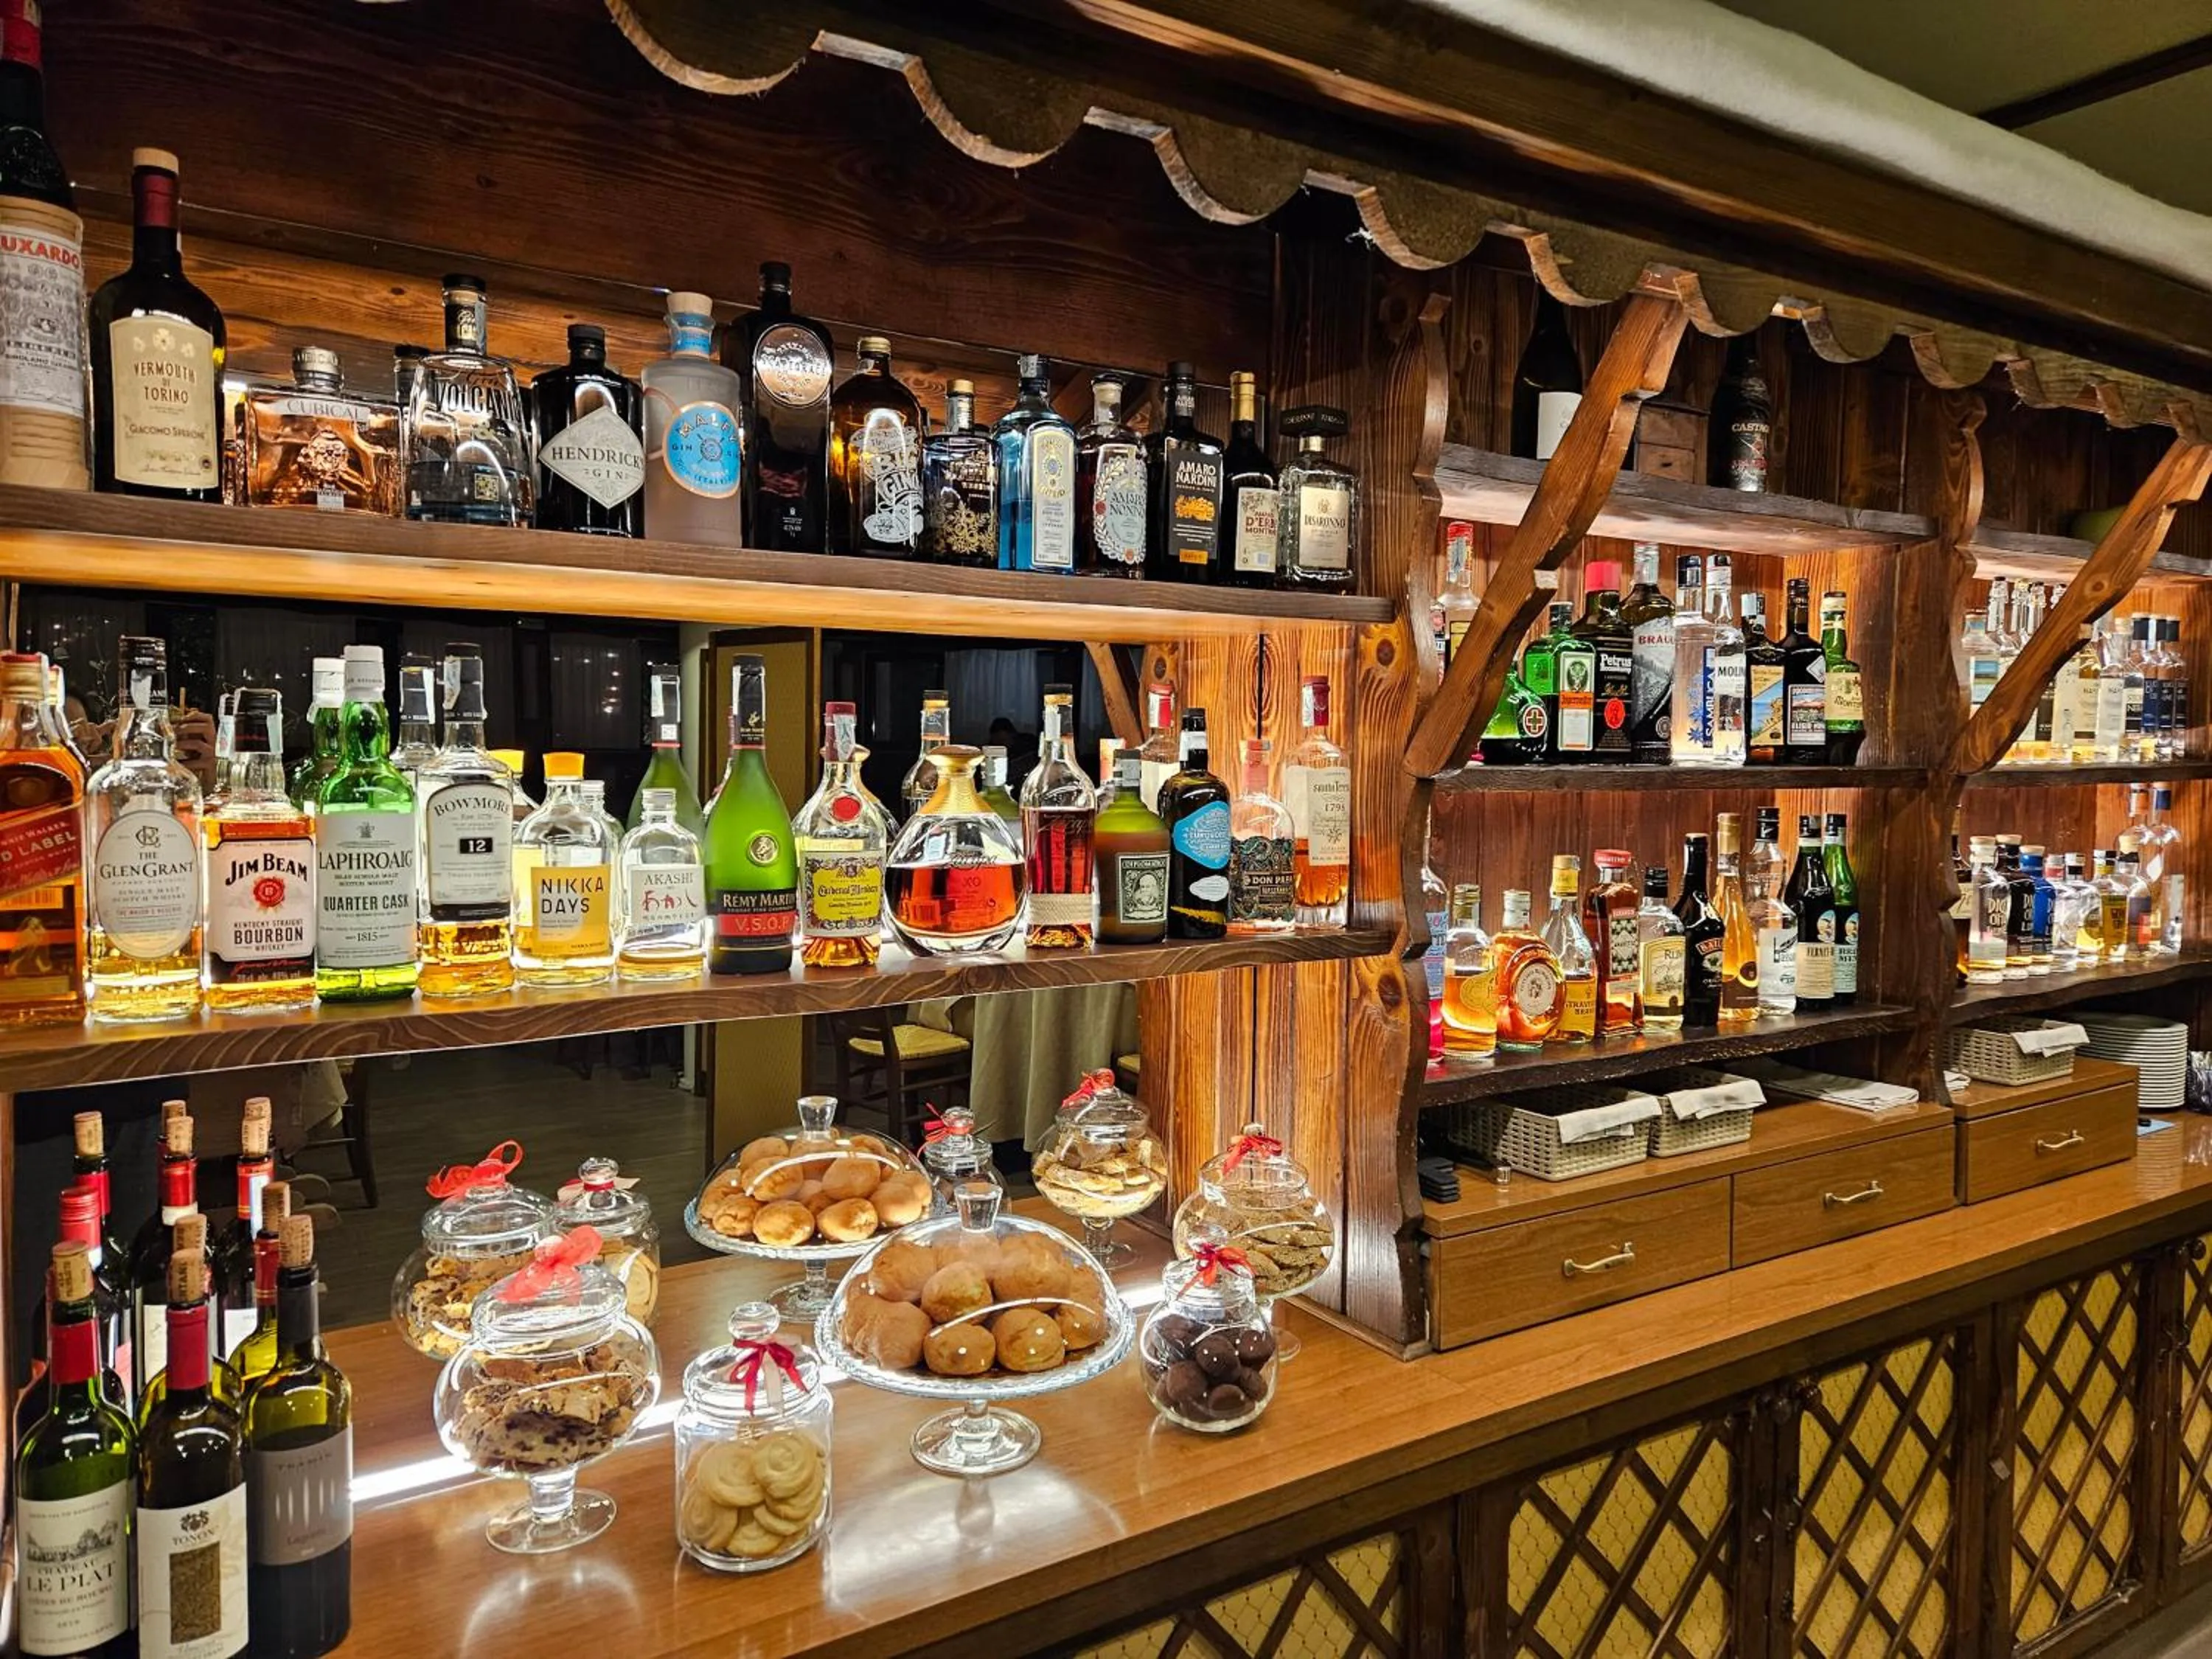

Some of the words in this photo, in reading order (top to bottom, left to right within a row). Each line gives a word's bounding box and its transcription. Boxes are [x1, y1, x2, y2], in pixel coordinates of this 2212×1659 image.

[0, 235, 80, 270] UXARDO
[134, 362, 196, 384] VERMOUTH
[145, 386, 189, 403] TORINO
[593, 468, 623, 480] GIN
[1178, 460, 1216, 476] AMARO
[1175, 471, 1217, 488] NARDINI
[18, 830, 77, 857] LABEL
[467, 839, 487, 852] 12
[139, 851, 159, 861] THE
[319, 849, 413, 871] LAPHROAIG
[225, 859, 258, 886] JIM
[263, 852, 307, 882] BEAM
[540, 876, 605, 895] NIKKA
[643, 872, 694, 886] AKASHI
[1253, 875, 1272, 885] DON
[323, 896, 378, 911] QUARTER
[382, 894, 409, 910] CASK
[540, 897, 591, 914] DAYS
[234, 927, 303, 945] BOURBON
[357, 932, 378, 942] 1815
[27, 1573, 52, 1593] LE
[60, 1559, 116, 1591] PLAT
